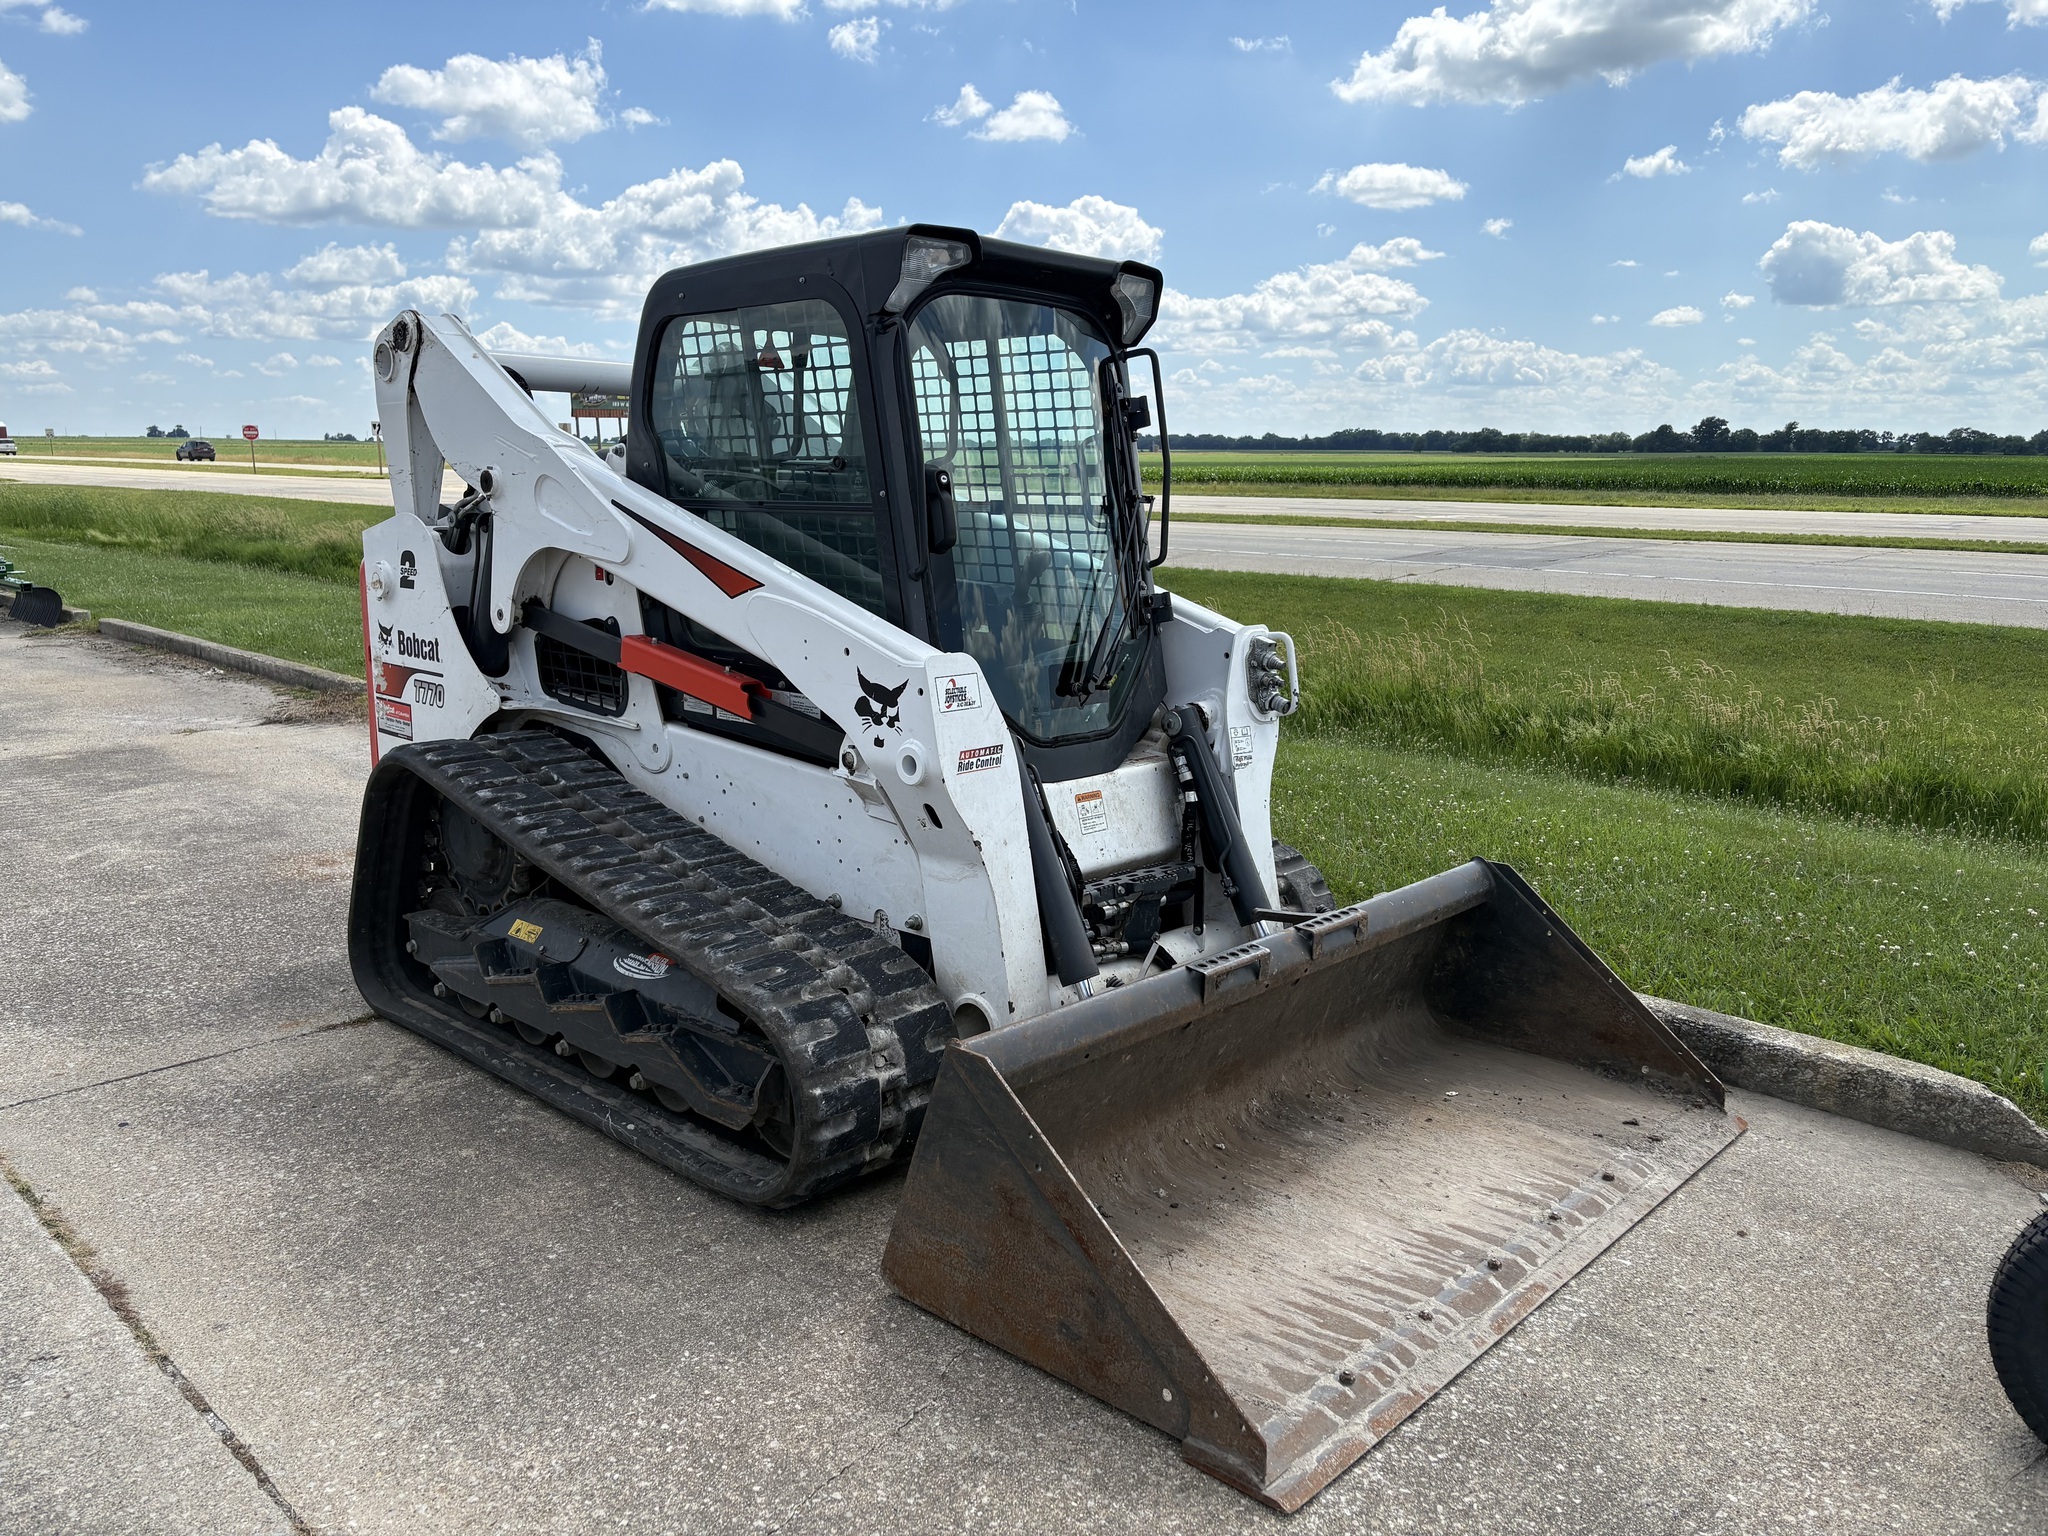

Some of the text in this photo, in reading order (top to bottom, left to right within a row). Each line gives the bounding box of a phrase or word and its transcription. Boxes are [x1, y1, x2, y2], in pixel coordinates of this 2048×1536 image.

[400, 550, 416, 589] 2
[400, 566, 417, 577] SPEED
[397, 630, 440, 662] Bobcat
[414, 679, 445, 709] T770
[960, 745, 1002, 760] AUTOMATIC
[957, 755, 1002, 772] Ride Control
[1081, 792, 1100, 800] WARNING
